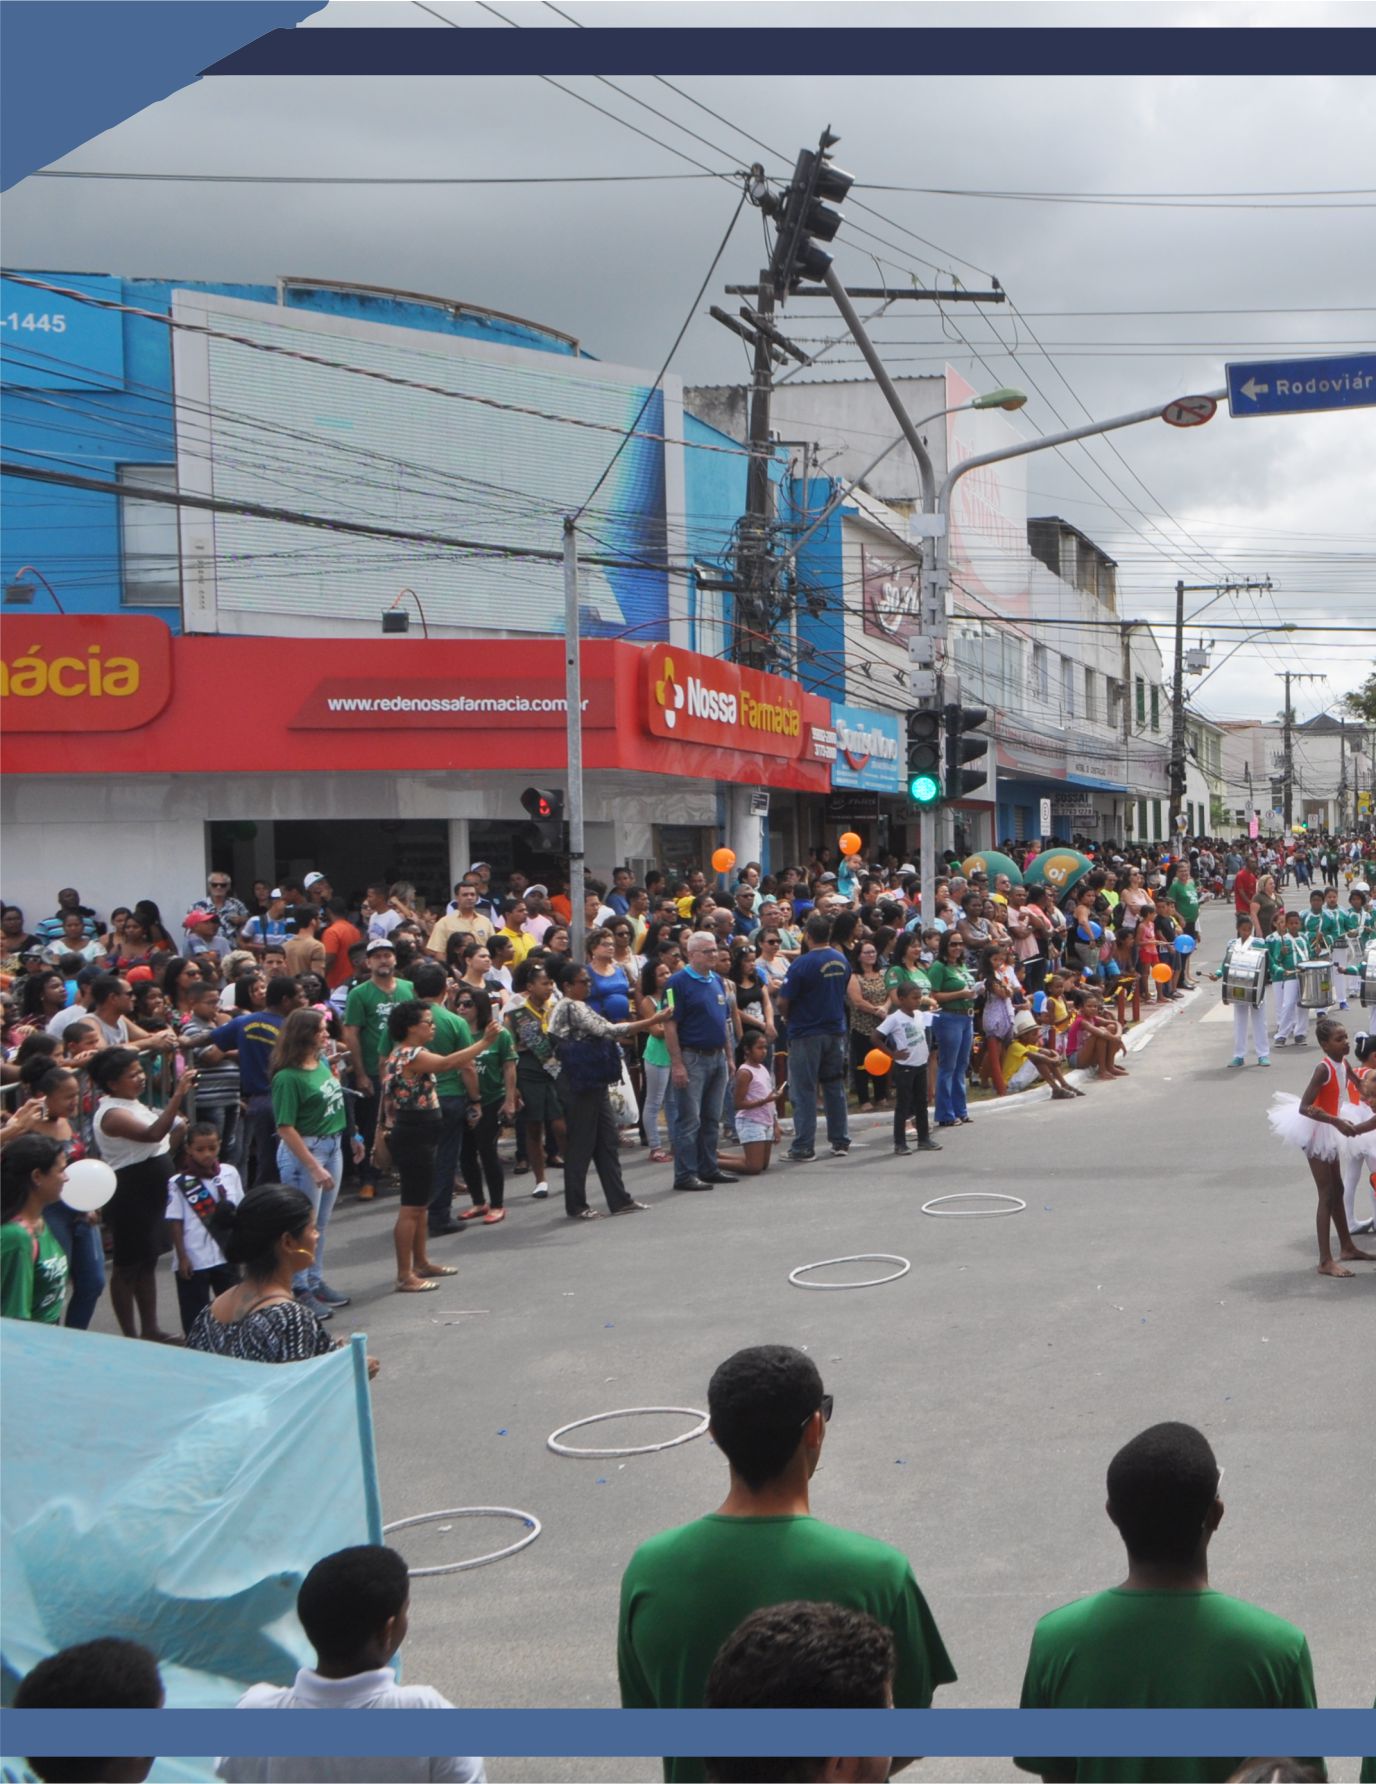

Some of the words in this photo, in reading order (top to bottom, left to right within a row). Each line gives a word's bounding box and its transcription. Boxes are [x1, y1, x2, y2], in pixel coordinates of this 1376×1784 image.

[0, 645, 140, 696] ácia
[687, 676, 737, 725] Nossa
[739, 690, 800, 737] Farmácia
[1048, 868, 1066, 881] oi
